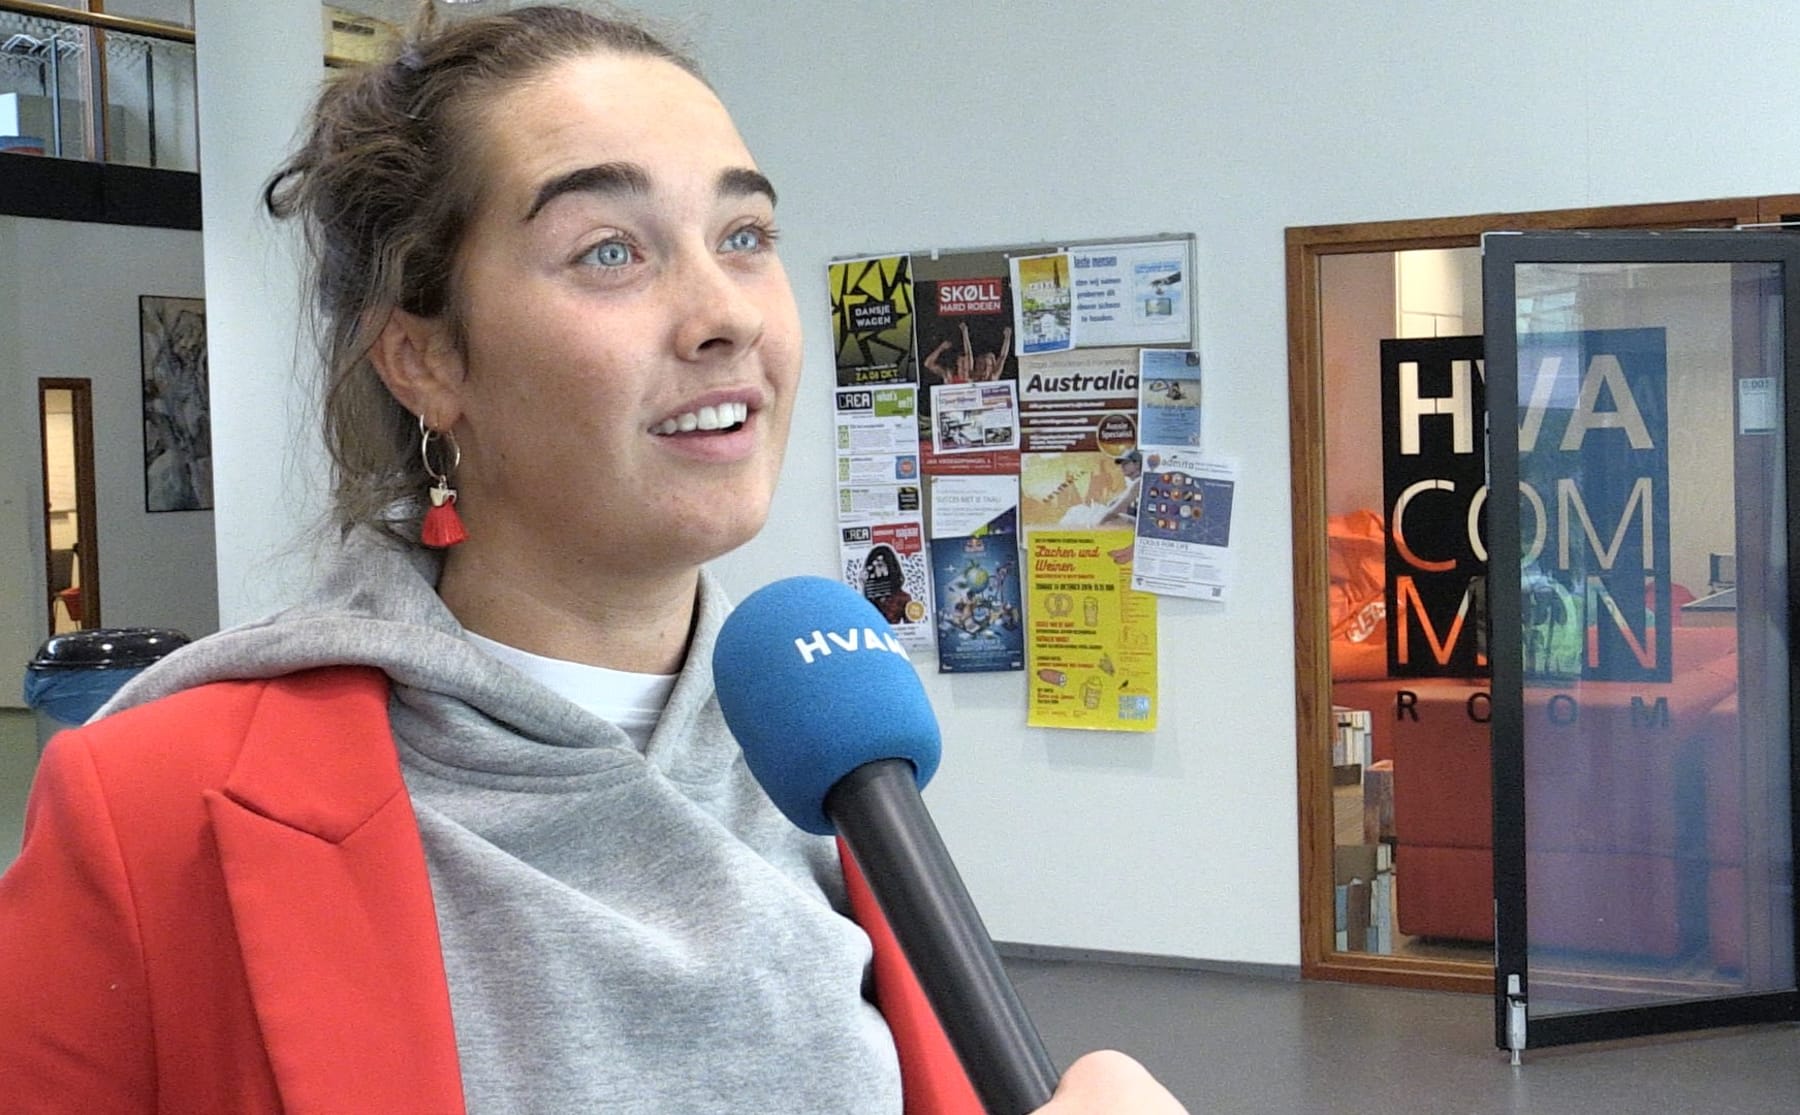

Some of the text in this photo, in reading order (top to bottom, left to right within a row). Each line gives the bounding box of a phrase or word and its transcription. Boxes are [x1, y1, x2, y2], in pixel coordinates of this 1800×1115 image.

[940, 284, 1001, 303] SKØLL
[855, 304, 891, 317] DANSJE
[940, 301, 1001, 313] HARD ROEIEN
[855, 316, 891, 327] WAGEN
[1025, 368, 1138, 393] Australia
[838, 393, 871, 408] CREA
[1399, 353, 1654, 455] HVA
[1391, 477, 1654, 572] COM
[845, 528, 869, 541] CREA
[1395, 690, 1669, 728] ROOM
